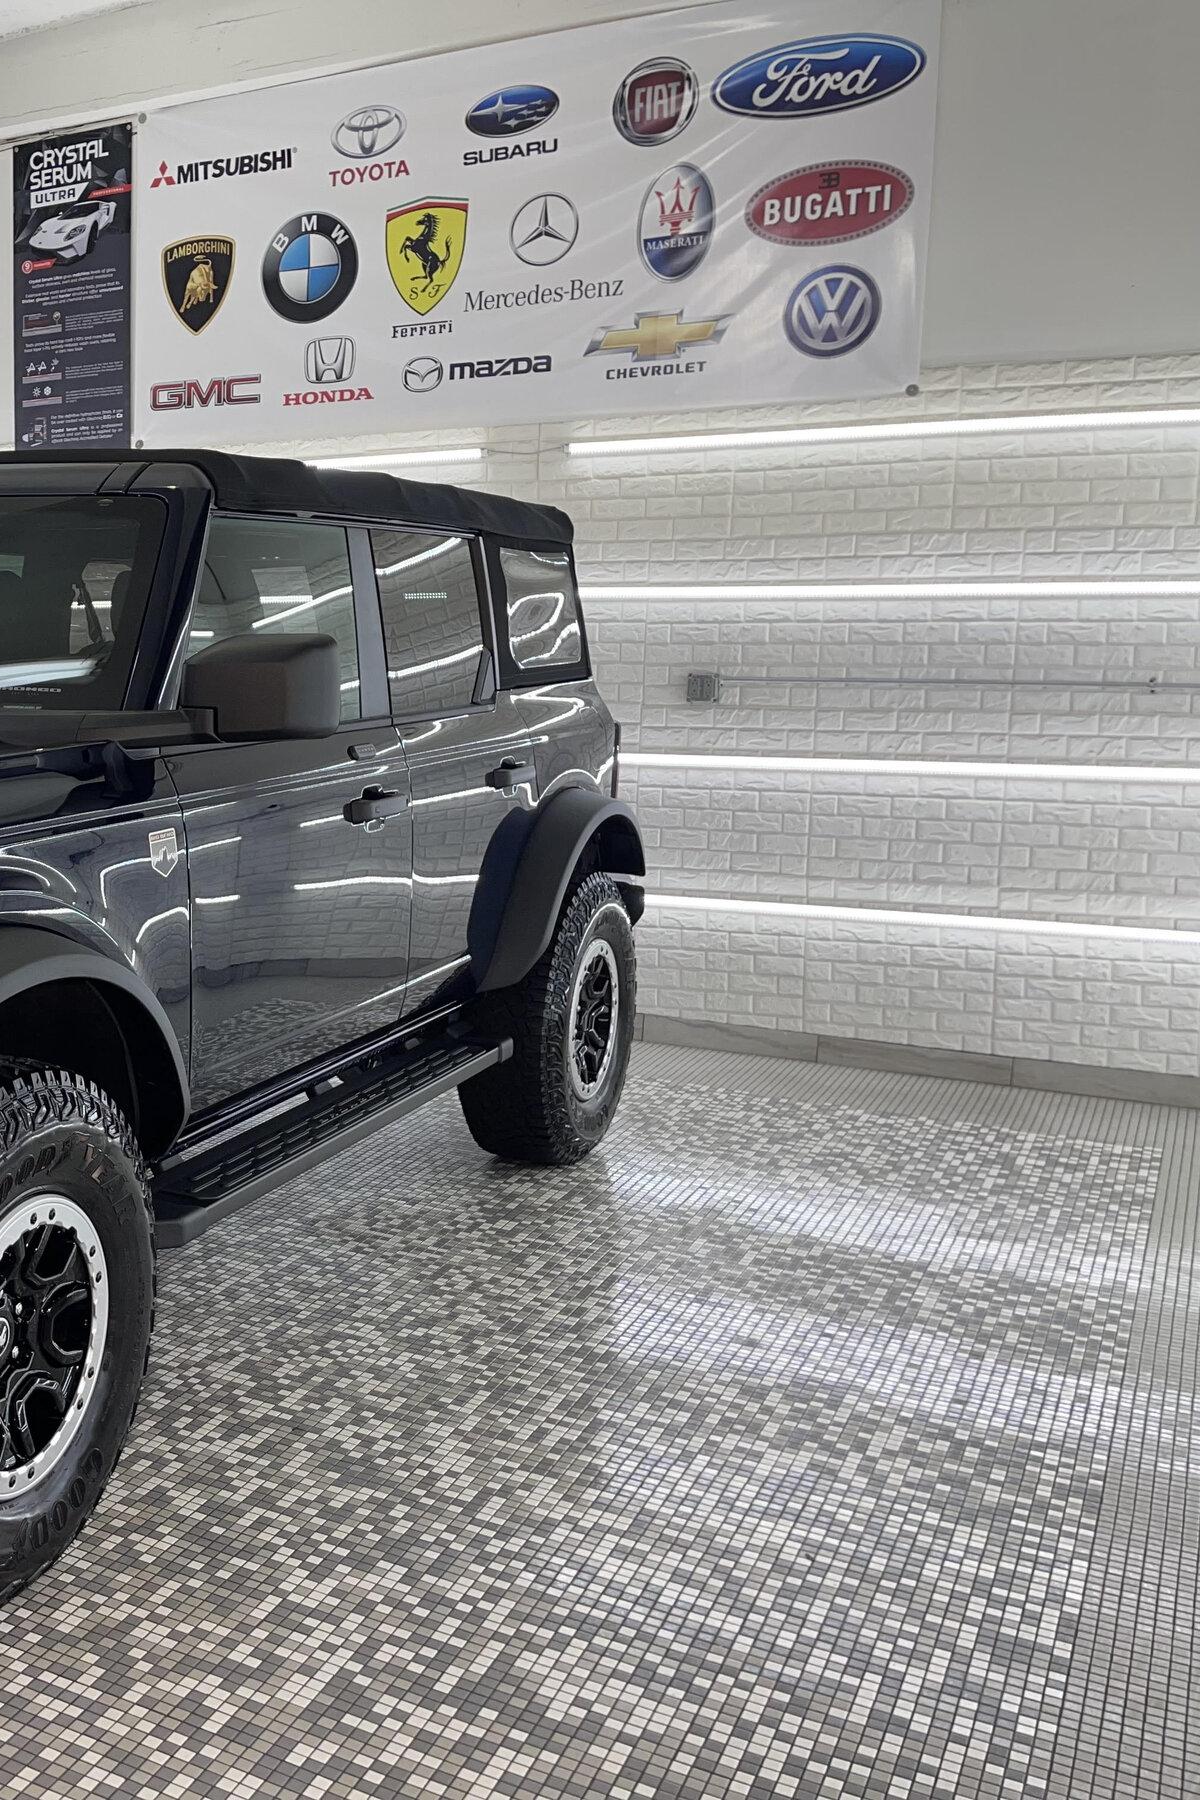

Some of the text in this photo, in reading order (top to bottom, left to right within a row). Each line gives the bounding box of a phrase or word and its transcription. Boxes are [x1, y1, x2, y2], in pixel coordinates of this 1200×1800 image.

[752, 48, 881, 107] Ford
[634, 79, 682, 123] FIAT
[29, 139, 109, 170] CRYSTAL
[177, 148, 293, 184] MITSUBISHI
[462, 138, 559, 166] SUBARU
[29, 161, 92, 190] SERUM
[328, 159, 410, 187] TOYOTA
[35, 187, 76, 204] ULTRA
[763, 184, 892, 227] BUGATTI
[166, 239, 231, 263] LAMBORGHINI
[646, 235, 704, 251] MASERATI
[463, 278, 624, 313] Mercedes-Benz
[391, 320, 453, 339] Ferrari
[605, 360, 708, 380] CHEVROLET
[150, 372, 262, 412] GMC
[282, 385, 375, 407] HONDA
